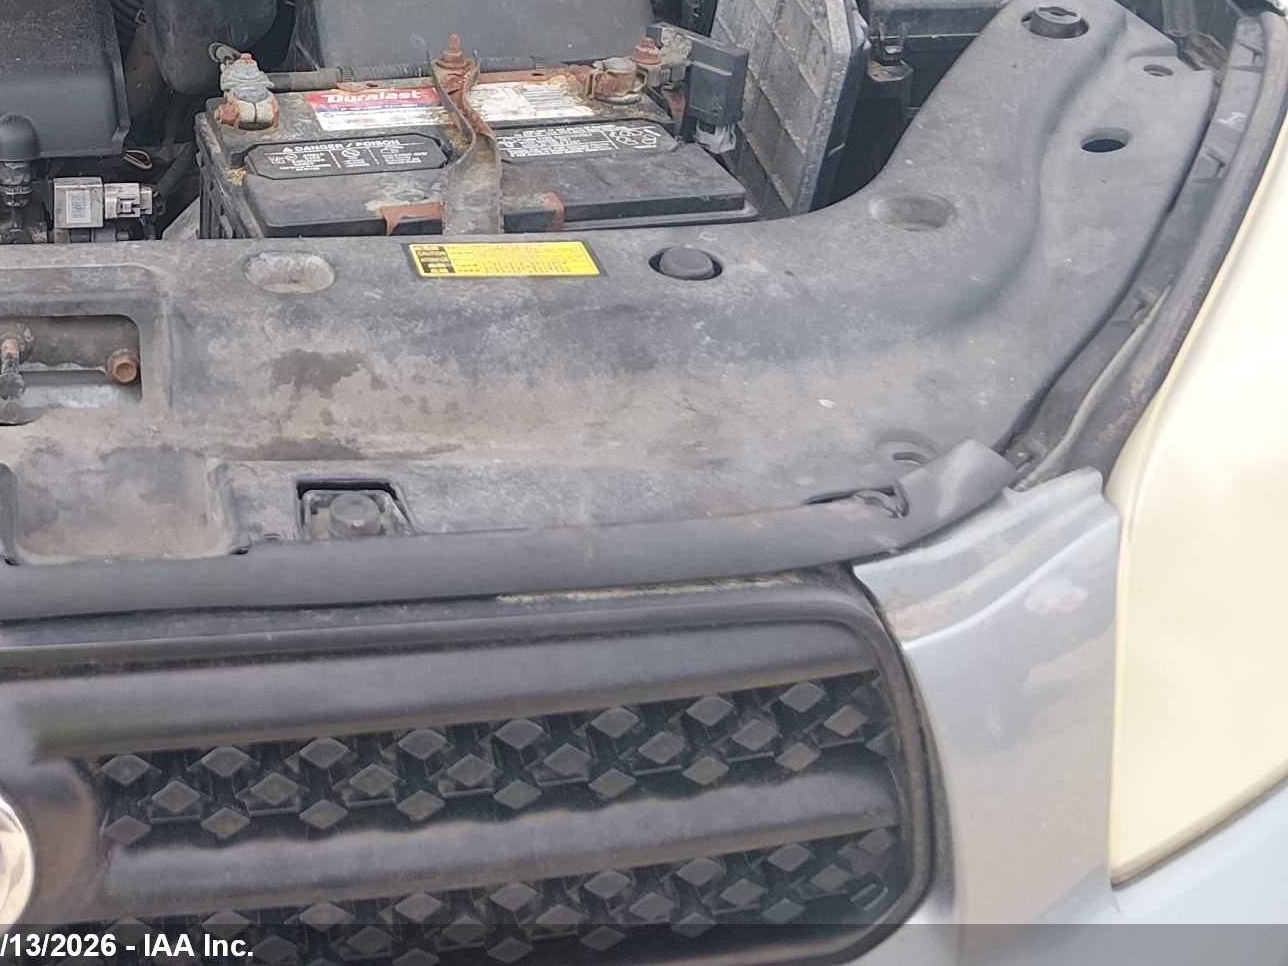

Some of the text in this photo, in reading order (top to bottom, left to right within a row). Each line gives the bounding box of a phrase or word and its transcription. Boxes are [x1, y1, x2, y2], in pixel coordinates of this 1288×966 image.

[321, 89, 422, 104] Duralast
[294, 143, 344, 152] DANGER
[355, 139, 401, 148] POISON
